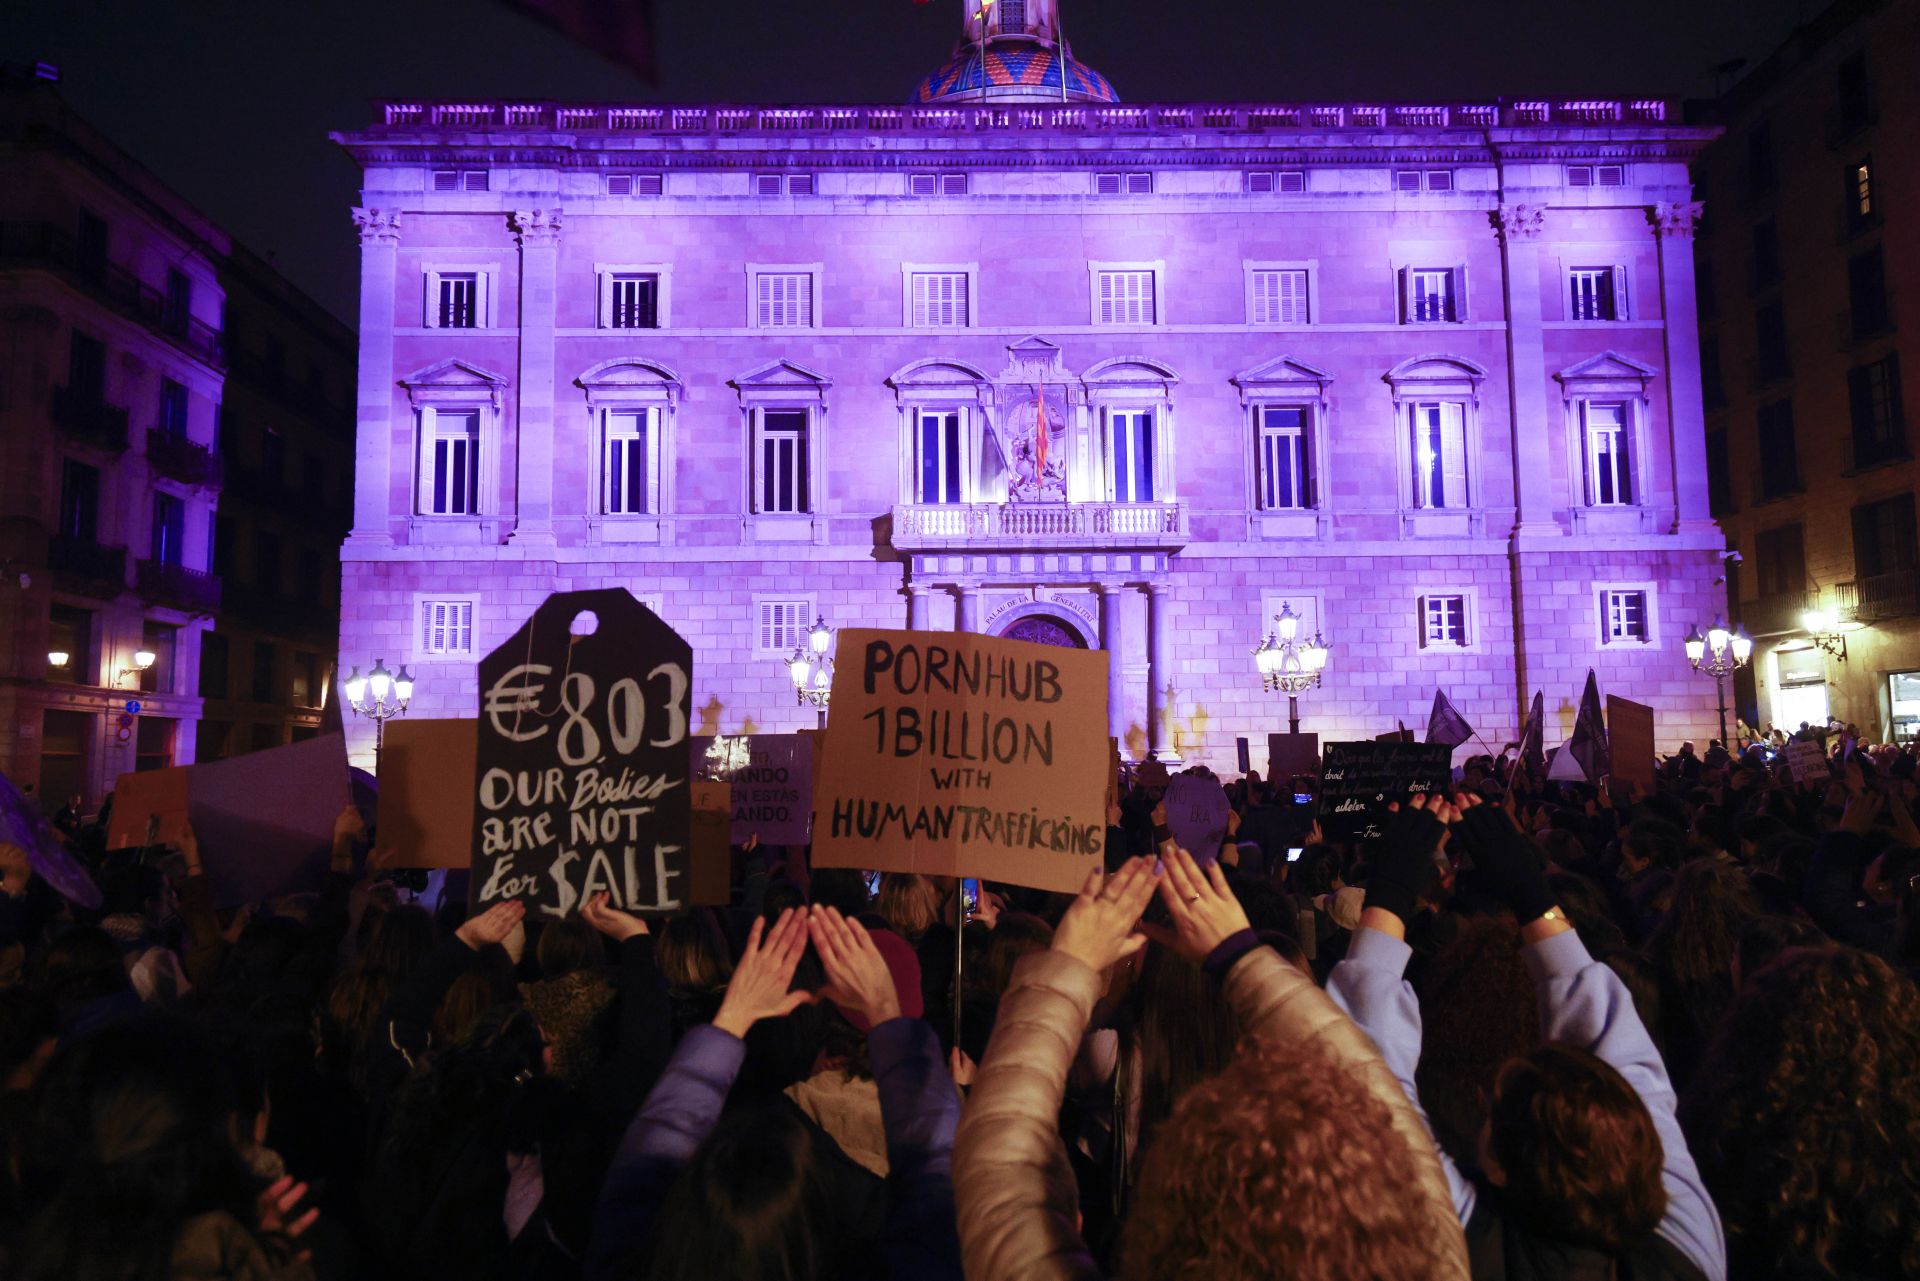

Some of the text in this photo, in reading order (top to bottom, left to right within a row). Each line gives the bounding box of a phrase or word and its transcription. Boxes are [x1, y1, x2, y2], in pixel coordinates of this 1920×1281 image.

[985, 605, 1006, 624] PALAU
[1007, 599, 1018, 607] DE
[1051, 596, 1096, 622] GENERALITAT
[864, 640, 1063, 703] PORNHUB
[479, 767, 685, 811] OUR Bodies
[930, 768, 991, 789] WITH
[569, 806, 656, 845] NOT
